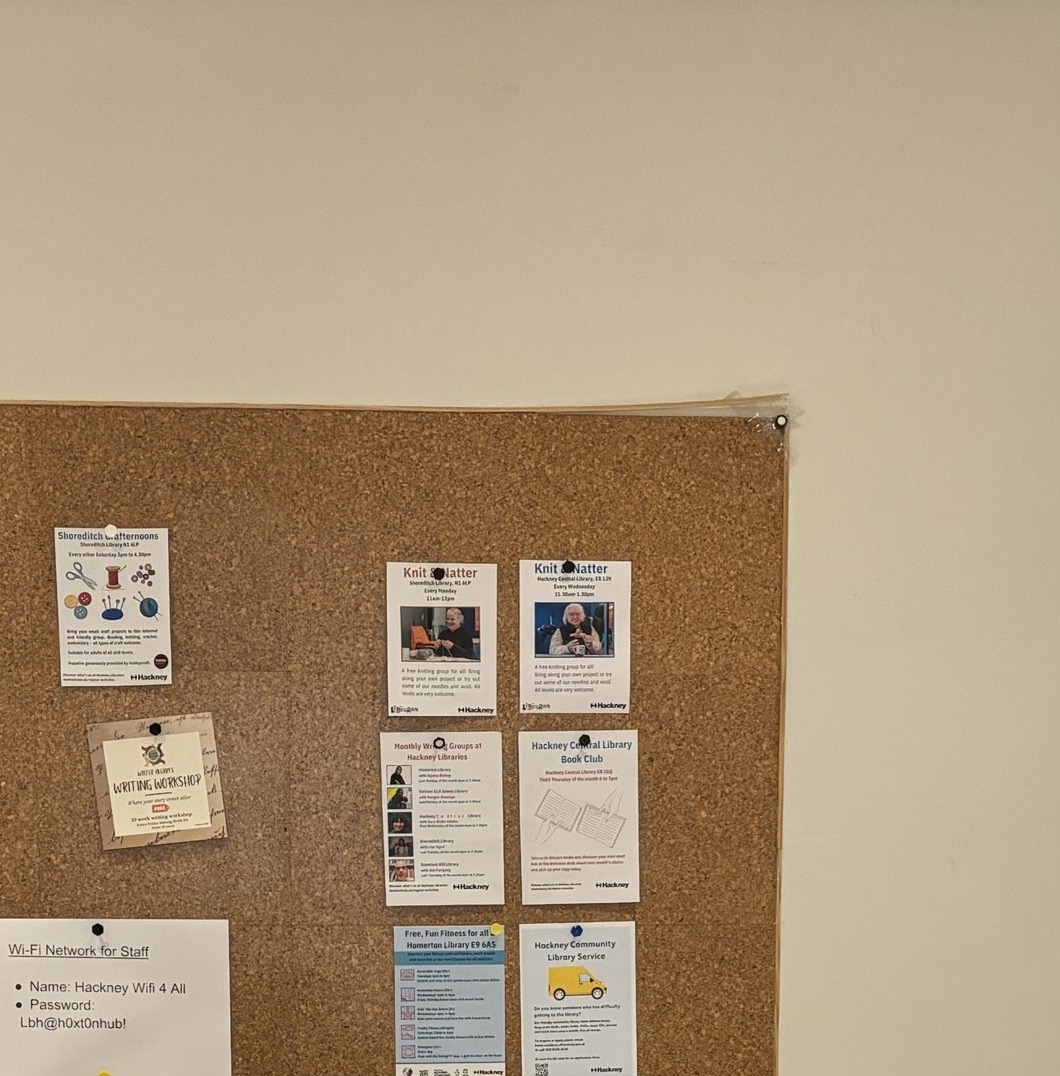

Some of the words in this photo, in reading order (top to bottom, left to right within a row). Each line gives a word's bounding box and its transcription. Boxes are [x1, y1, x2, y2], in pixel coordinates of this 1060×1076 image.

[58, 532, 103, 540] Shoreditch
[404, 567, 426, 578] Knit
[535, 563, 557, 573] Knit
[572, 563, 607, 574] Natter
[532, 742, 568, 751] Hackney
[603, 741, 632, 750] Library
[562, 755, 582, 763] Book
[584, 755, 603, 763] Club
[114, 779, 152, 794] WRITING
[154, 774, 201, 789] WORKSHOP
[405, 930, 423, 938] Free,
[444, 941, 469, 949] Library
[535, 942, 568, 950] Hackney
[9, 944, 41, 955] Wi-Fi
[46, 945, 96, 956] Network
[101, 946, 116, 956] for
[121, 946, 149, 957] Staff
[548, 954, 575, 962] Library
[30, 981, 70, 992] Name:
[76, 982, 128, 995] Hackney
[133, 983, 155, 993] Wifi
[159, 983, 166, 993] 4
[171, 983, 185, 994] All
[31, 999, 94, 1010] Password:
[21, 1017, 125, 1030] Lbh@h0xt0nhub!
